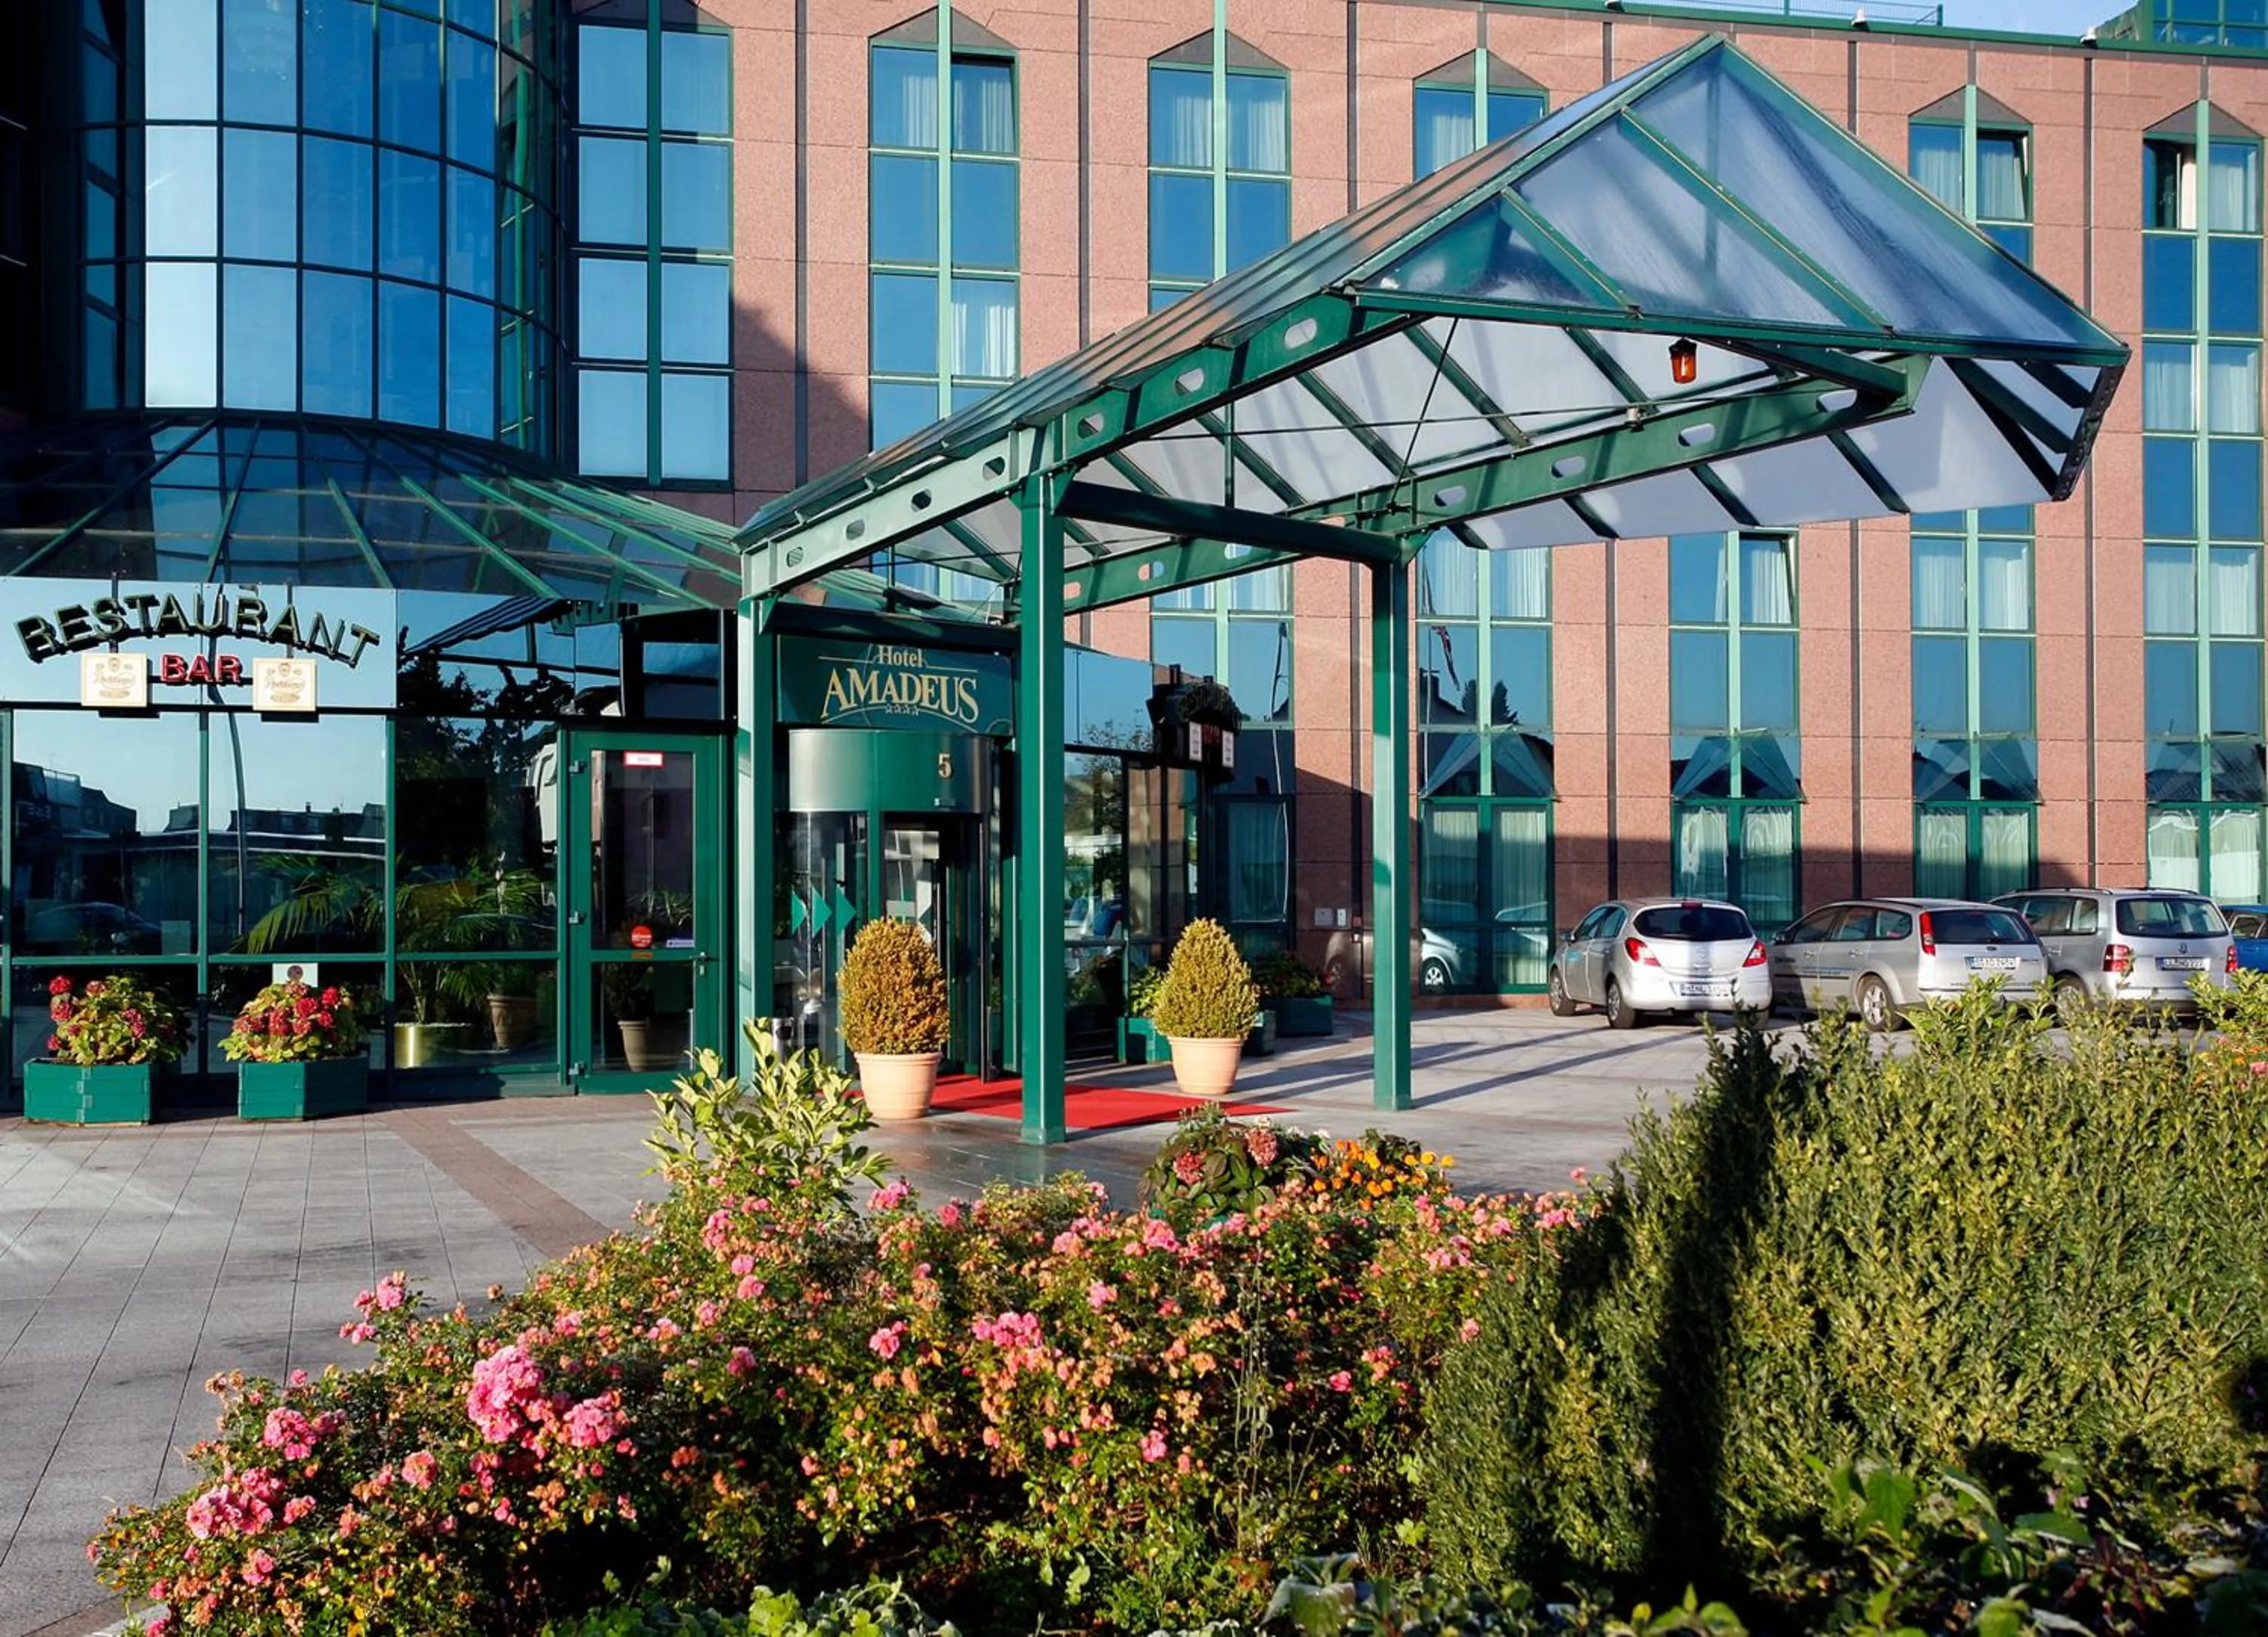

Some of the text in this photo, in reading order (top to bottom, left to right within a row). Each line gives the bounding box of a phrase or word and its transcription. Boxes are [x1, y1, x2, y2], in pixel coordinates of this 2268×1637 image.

[14, 593, 381, 667] RESTAURANT
[160, 654, 243, 683] BAR
[877, 645, 924, 667] Hotel
[820, 668, 979, 723] AMADEUS
[938, 754, 953, 778] 5
